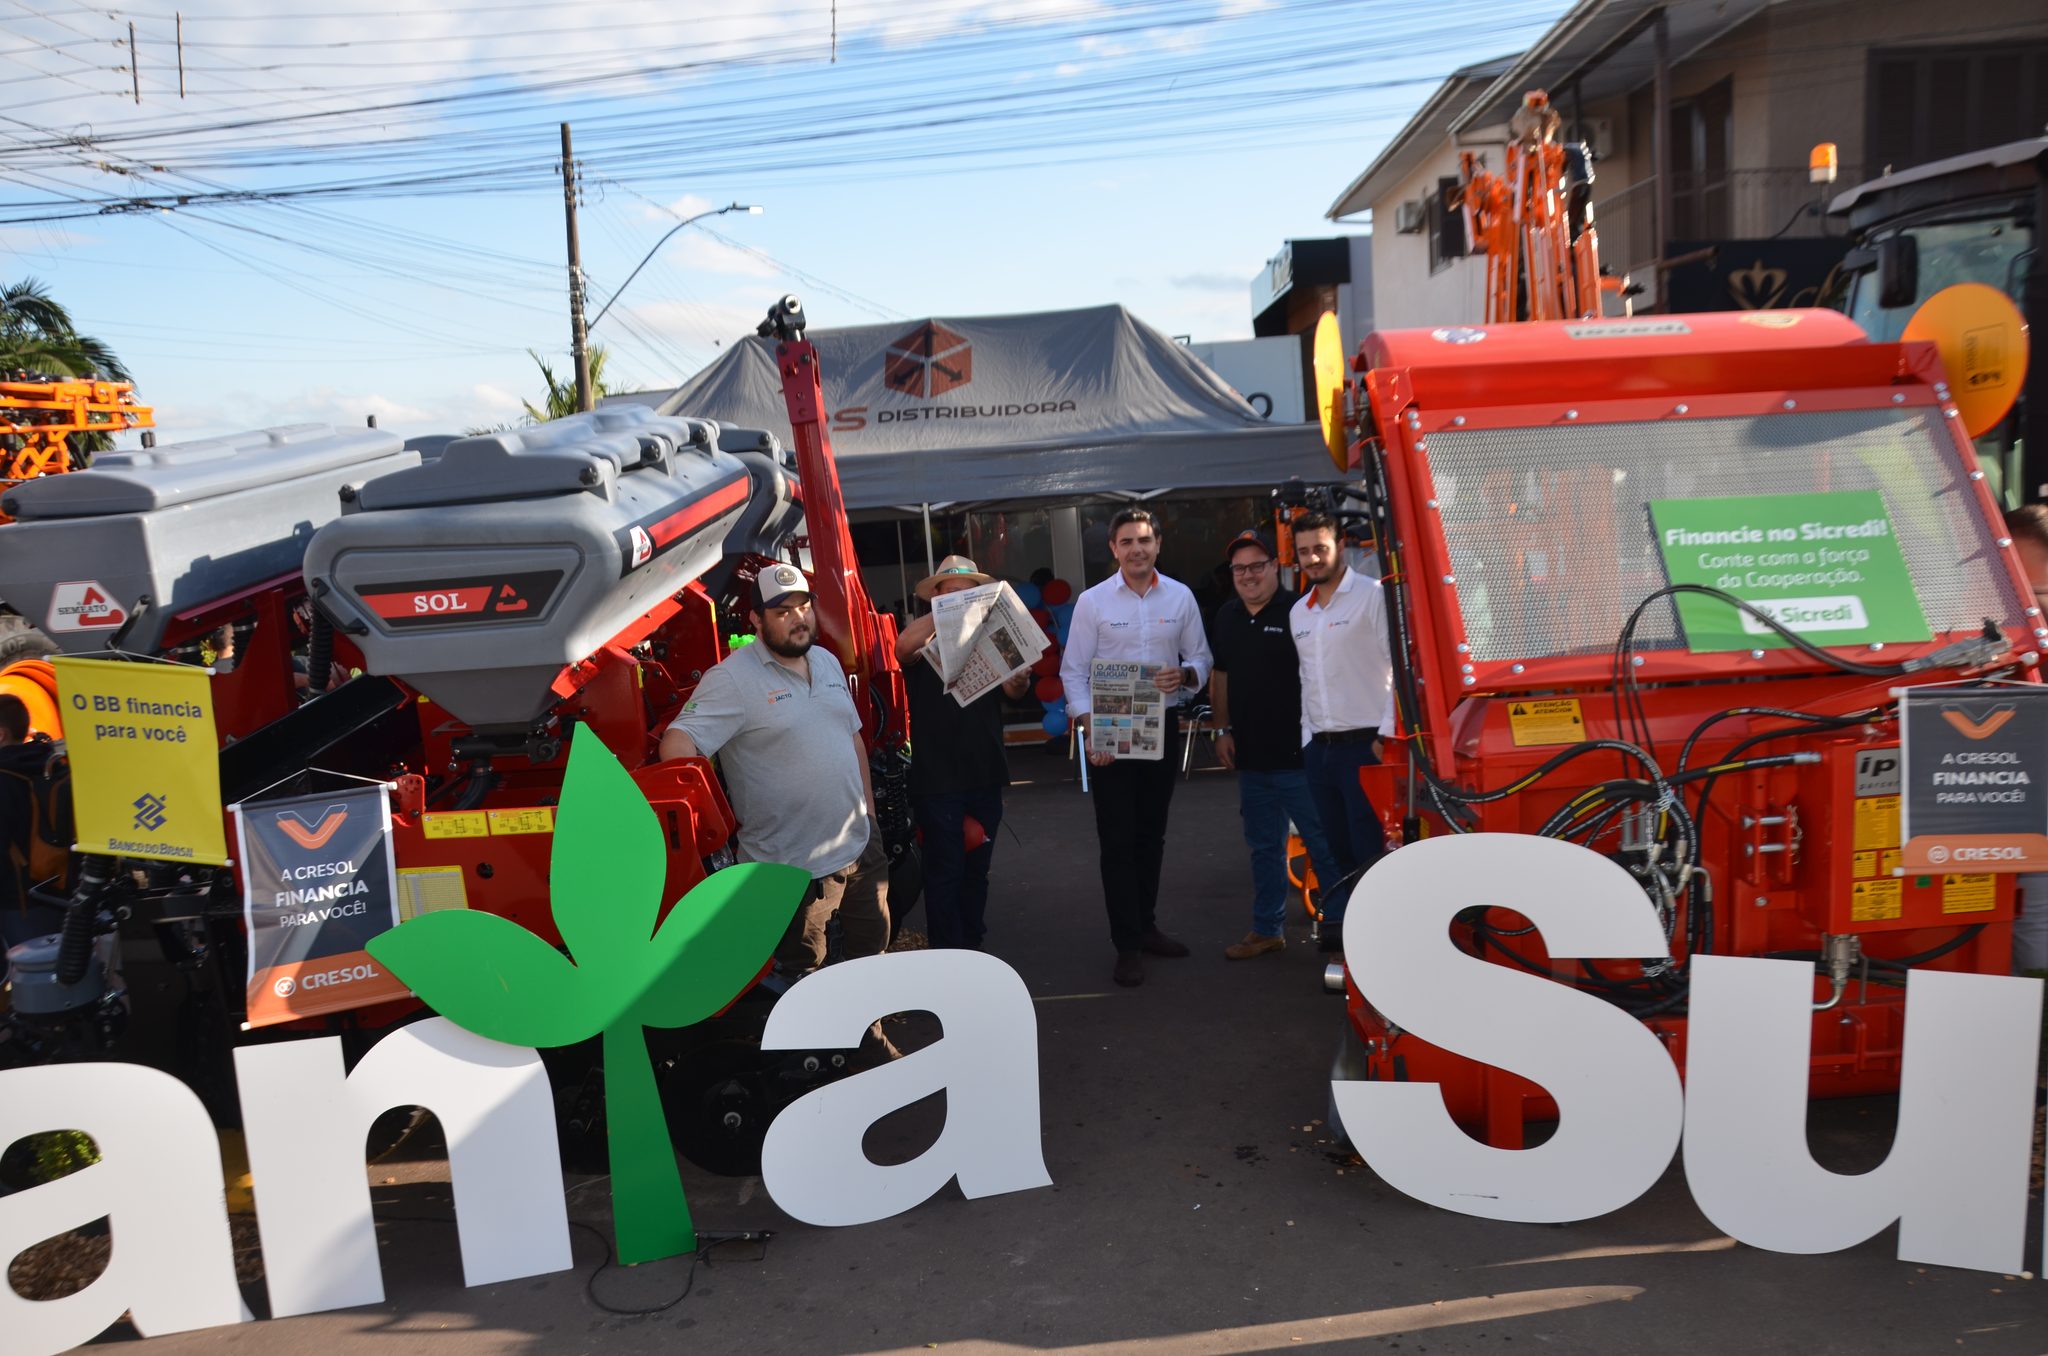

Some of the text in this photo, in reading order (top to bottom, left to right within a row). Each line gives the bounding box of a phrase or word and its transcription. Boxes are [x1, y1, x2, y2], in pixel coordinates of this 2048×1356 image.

[877, 401, 1076, 424] DISTRIBUIDORA
[1665, 518, 1888, 547] Financie no Sicredi!
[1698, 547, 1869, 570] Conte com a força
[1717, 569, 1865, 590] da Cooperação.
[58, 604, 108, 616] SEMEATO
[413, 592, 467, 613] SOL
[1782, 604, 1853, 624] Sicredi
[1105, 663, 1128, 671] ALTO
[73, 694, 202, 718] O BB financia
[95, 724, 187, 743] para você
[1941, 752, 2021, 765] A CRESOL
[1932, 771, 2031, 786] FINANCIA
[1936, 789, 2025, 804] PARA VOCÊ!
[1953, 847, 2027, 861] CRESOL
[281, 861, 358, 882] A CRESOL
[275, 879, 370, 907] FINANCIA
[280, 900, 367, 928] PARA VOCÊ!
[301, 964, 379, 990] CRESOL
